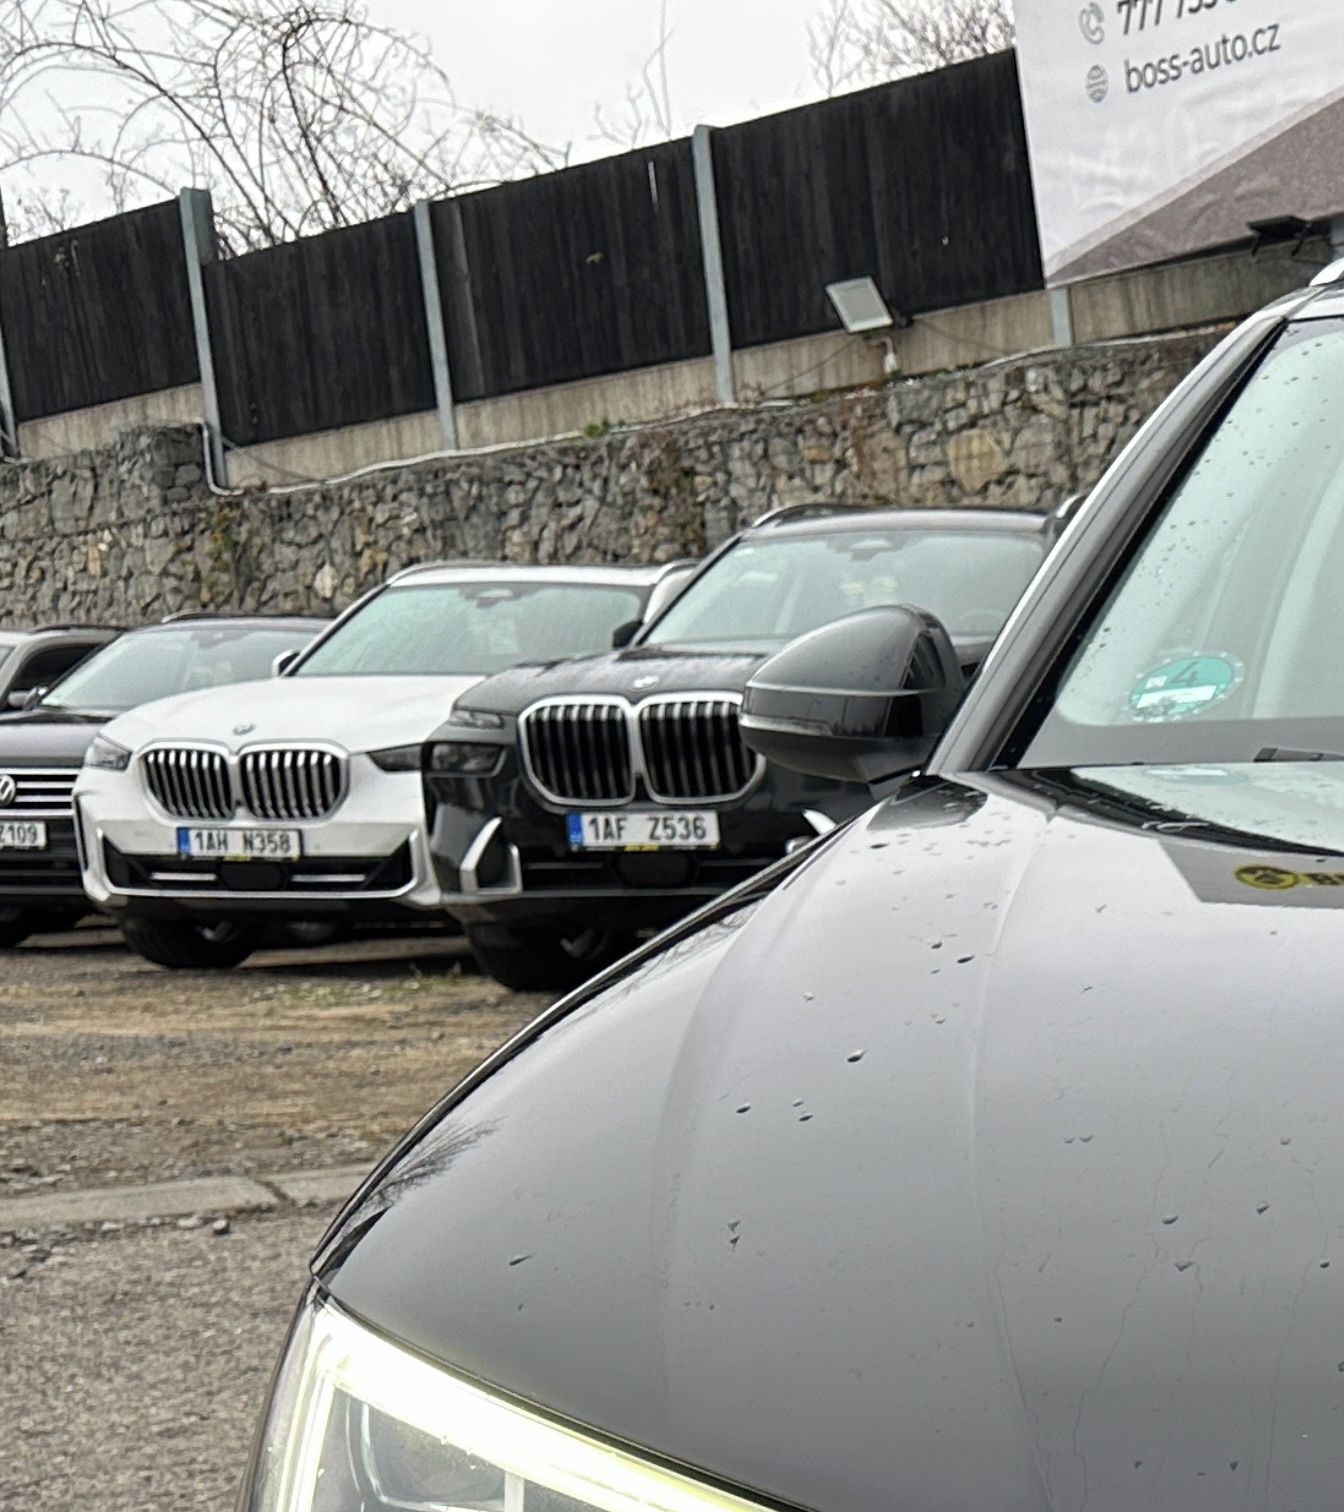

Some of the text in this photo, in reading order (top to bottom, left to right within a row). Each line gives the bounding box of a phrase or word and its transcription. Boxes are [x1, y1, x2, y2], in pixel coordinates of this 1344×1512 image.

[1124, 22, 1281, 93] boss-auto.cz
[588, 815, 707, 841] 1AF Z536
[194, 831, 292, 853] 1AH N358
